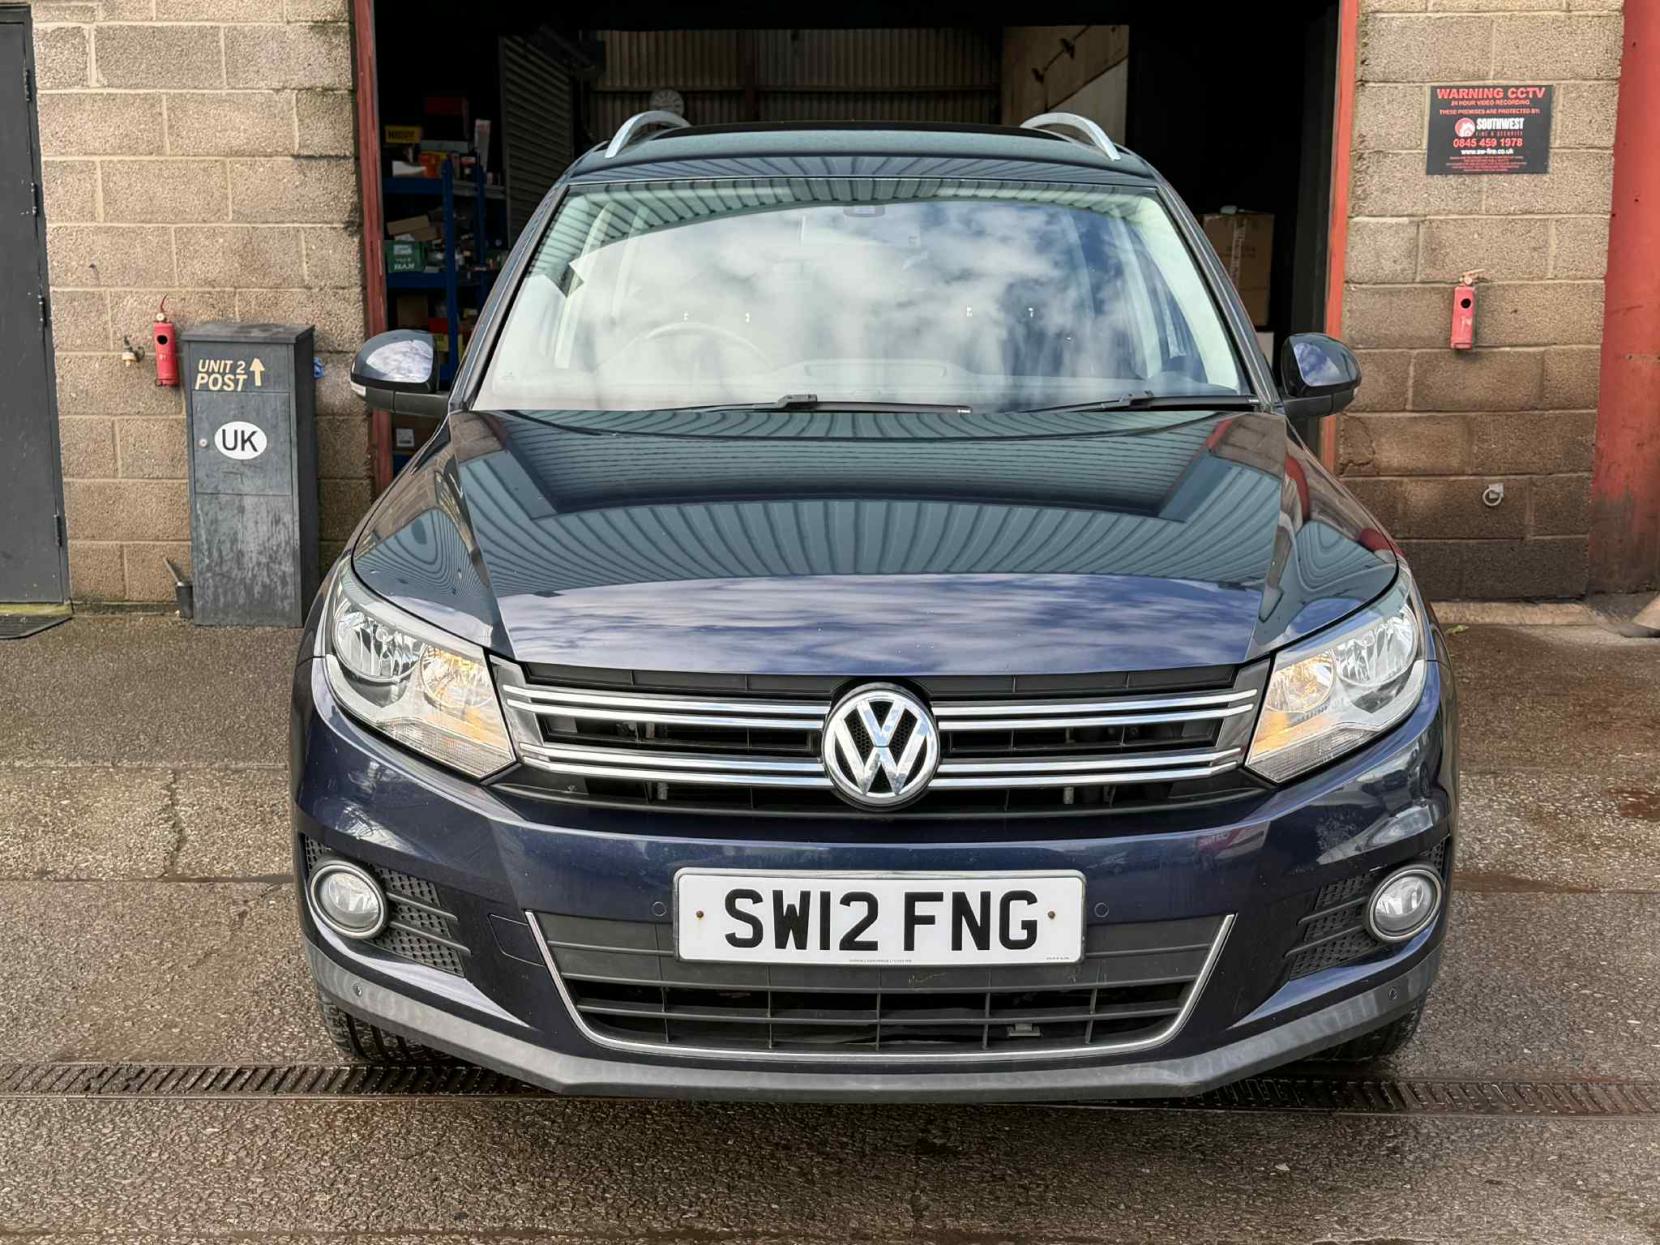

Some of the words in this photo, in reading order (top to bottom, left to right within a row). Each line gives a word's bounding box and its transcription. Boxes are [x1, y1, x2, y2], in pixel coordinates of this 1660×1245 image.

[1437, 88, 1504, 99] WARNING
[1508, 87, 1545, 98] CCTV
[1476, 117, 1524, 130] SOUTHWEST
[1453, 138, 1477, 148] 0845
[1479, 138, 1497, 147] 459
[1500, 137, 1523, 147] 1978
[198, 359, 233, 373] UNIT
[236, 361, 247, 374] 2
[195, 373, 248, 392] POST
[221, 428, 258, 453] UK
[823, 689, 938, 800] VW
[724, 888, 879, 952] SW12
[903, 889, 1038, 952] FNG
